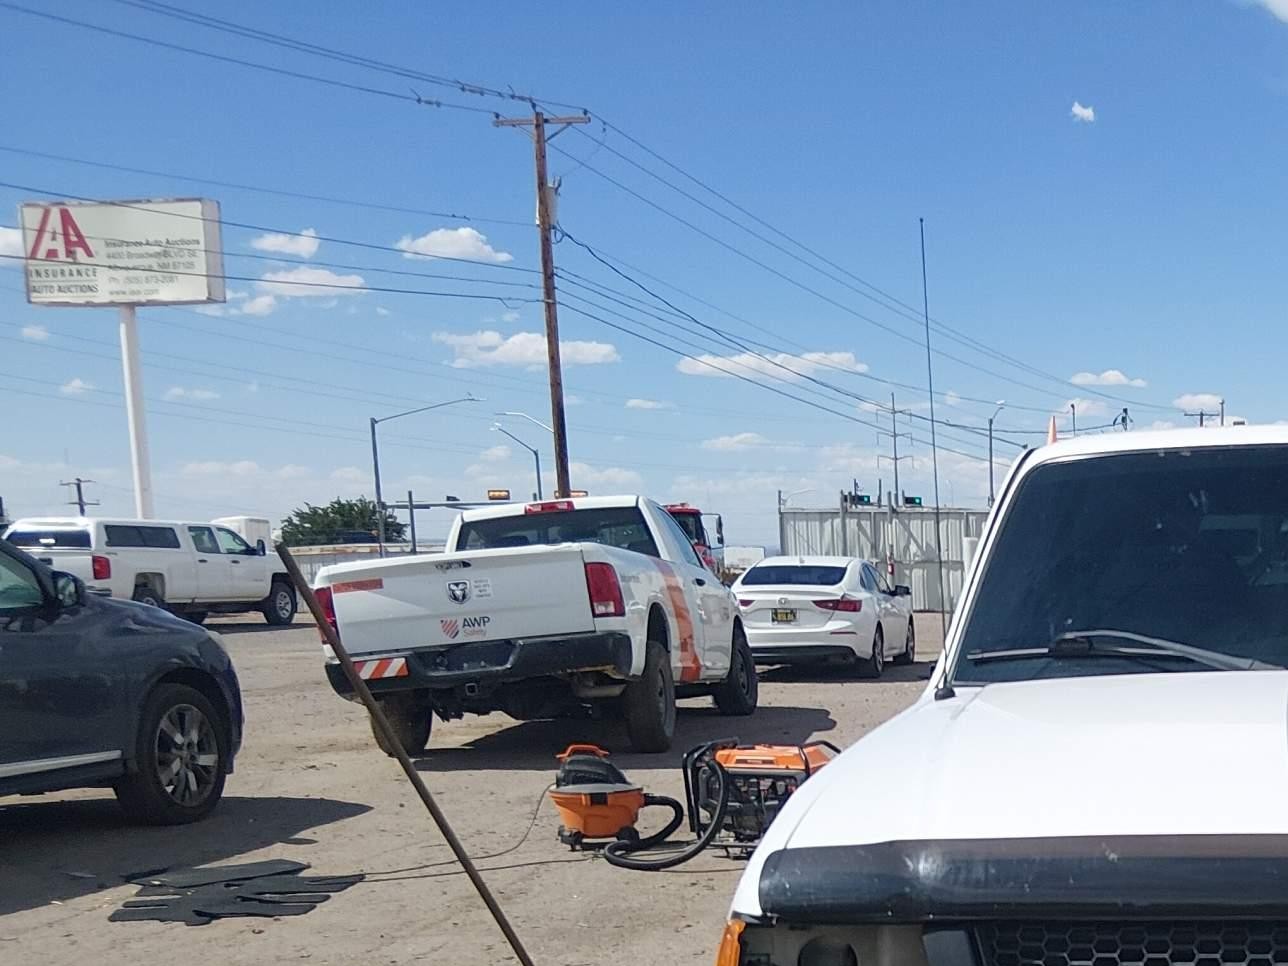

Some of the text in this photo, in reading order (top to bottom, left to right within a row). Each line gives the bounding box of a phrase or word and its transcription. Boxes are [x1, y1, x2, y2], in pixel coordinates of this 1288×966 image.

[30, 267, 97, 278] INSURANCE
[32, 283, 99, 294] AUTO AUCTIONS
[462, 616, 490, 628] AWP
